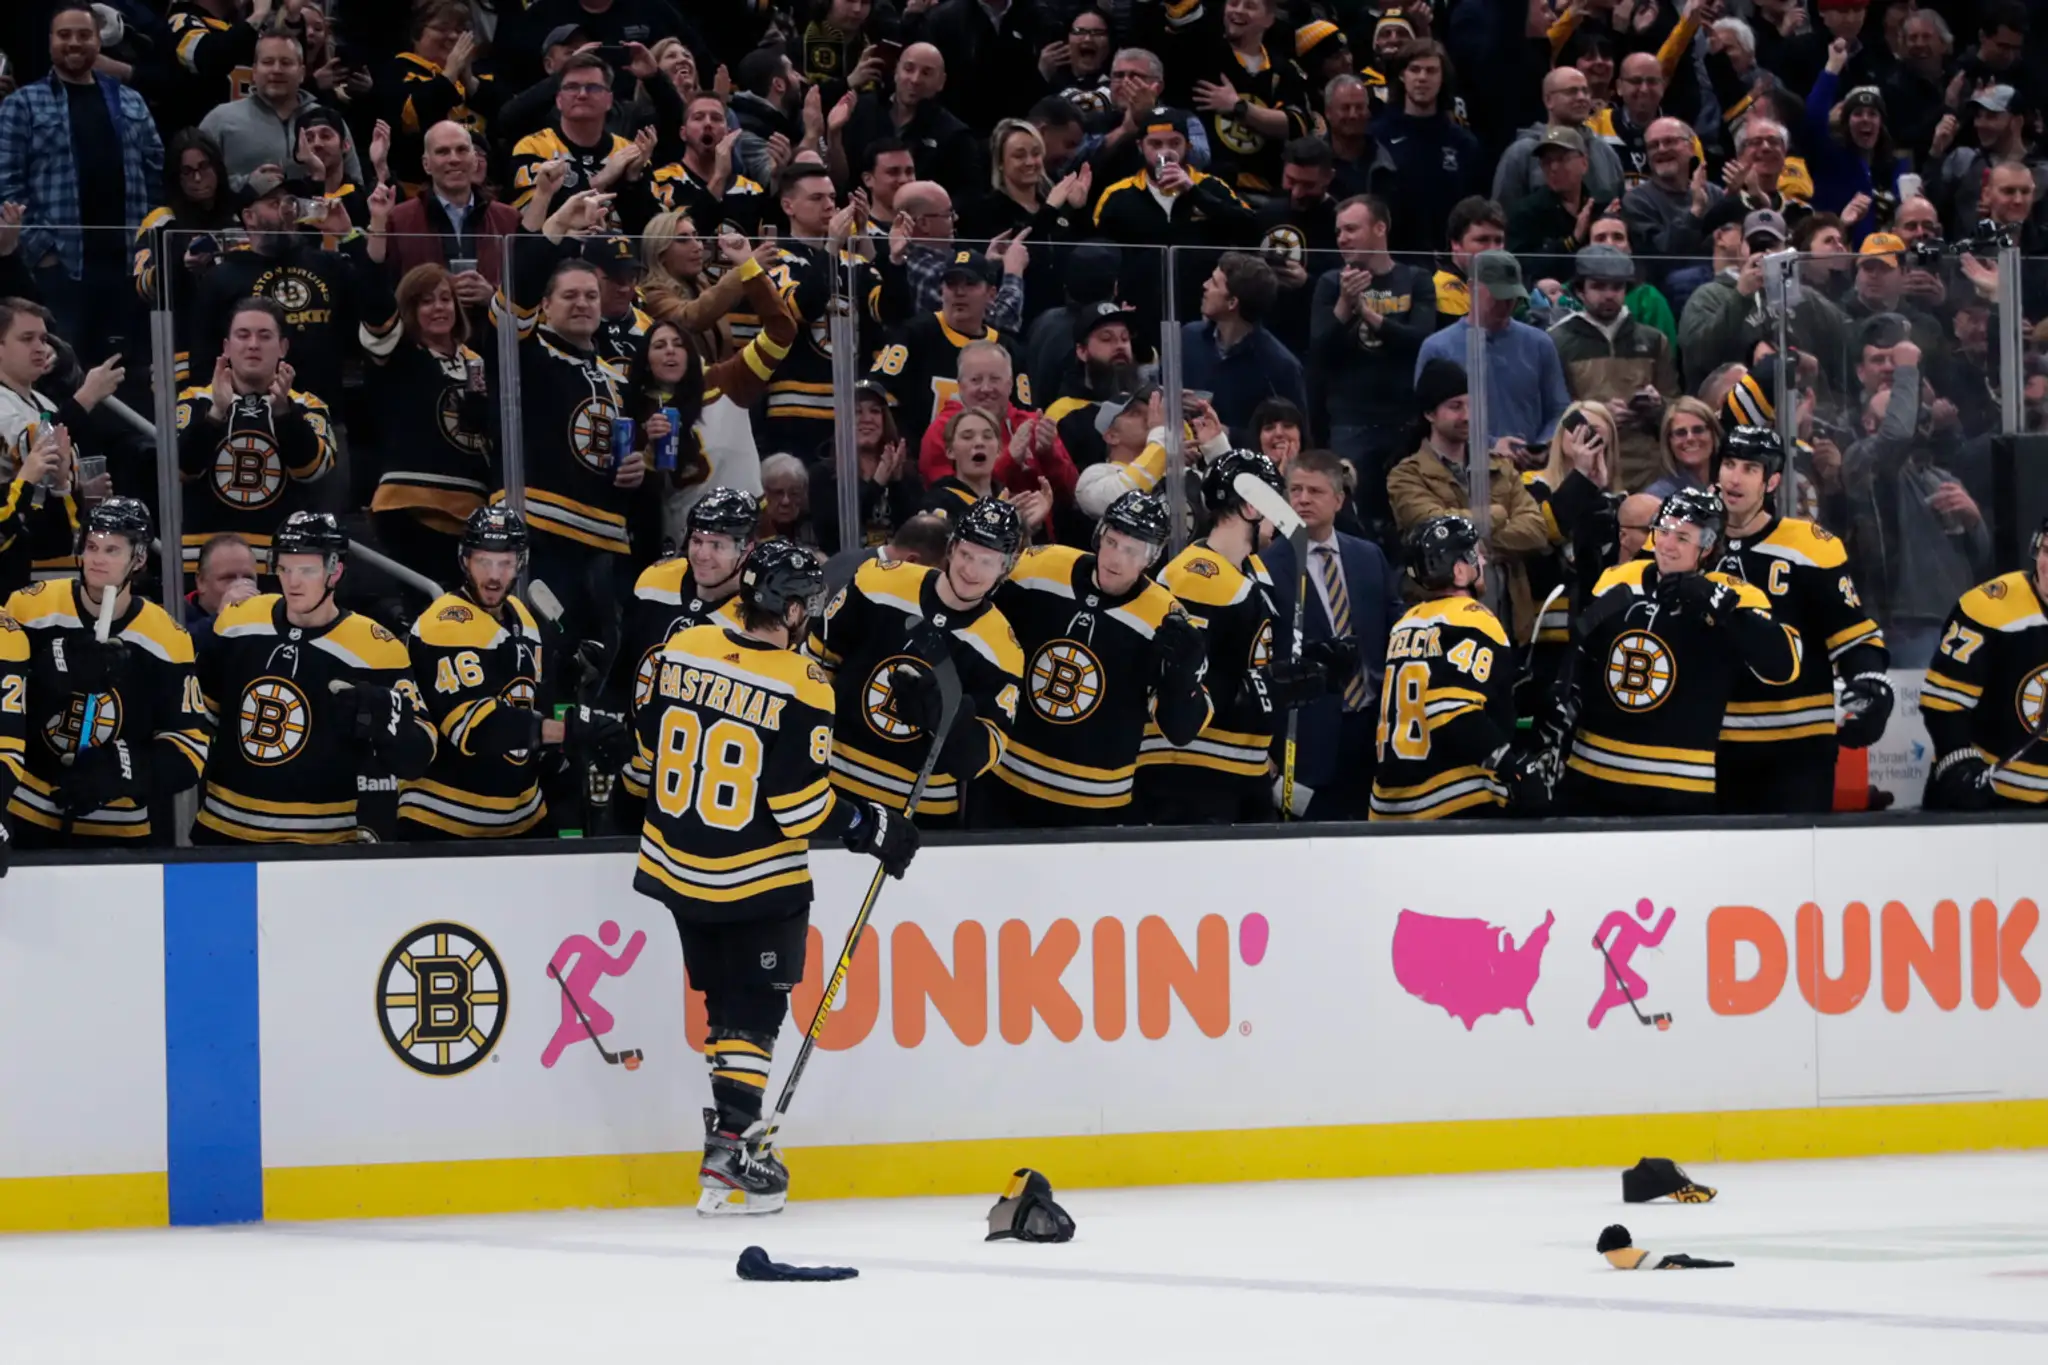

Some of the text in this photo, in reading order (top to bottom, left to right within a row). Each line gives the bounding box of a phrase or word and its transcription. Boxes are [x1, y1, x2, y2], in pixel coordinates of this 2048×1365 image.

[1768, 559, 1791, 597] C
[434, 650, 487, 697] 46
[1446, 636, 1494, 685] 48
[0, 673, 27, 715] 2
[659, 662, 788, 731] PASTRNAK
[656, 704, 764, 832] 88
[809, 725, 834, 765] 8
[684, 911, 1270, 1053] UNKIN'
